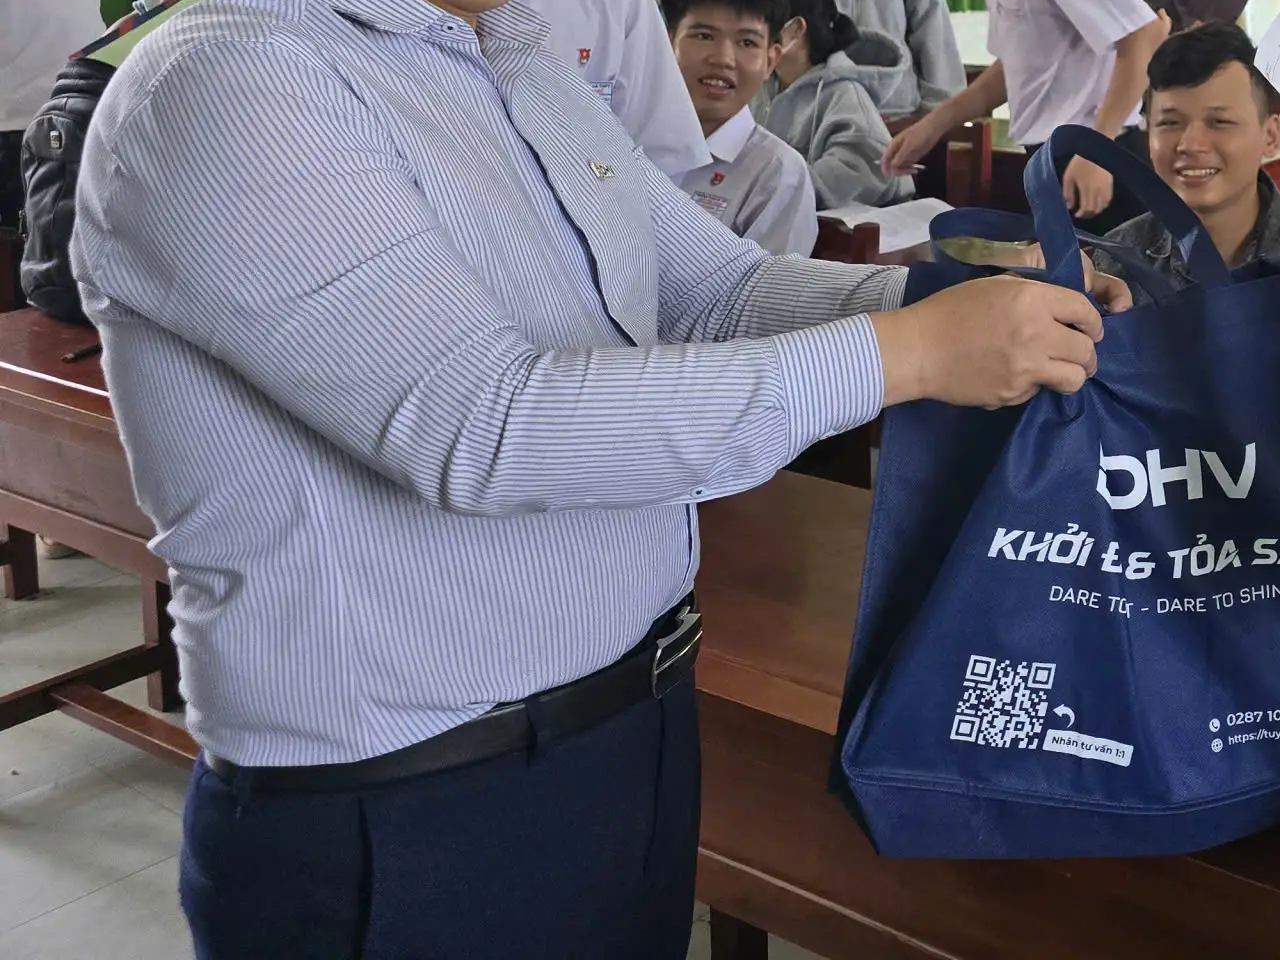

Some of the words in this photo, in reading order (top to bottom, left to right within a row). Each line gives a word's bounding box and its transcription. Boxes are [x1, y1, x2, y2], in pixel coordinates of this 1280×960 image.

[1096, 441, 1256, 510] DHV
[987, 522, 1095, 568] KHỞI
[1167, 533, 1242, 579] TỎA
[1049, 585, 1101, 610] DARE
[1157, 597, 1207, 614] DARE
[1212, 592, 1234, 611] TO
[1226, 711, 1263, 727] 0287
[1051, 736, 1079, 748] Nhận
[1081, 742, 1094, 751] tư
[1094, 744, 1113, 755] vấn
[1115, 748, 1126, 759] 1:1
